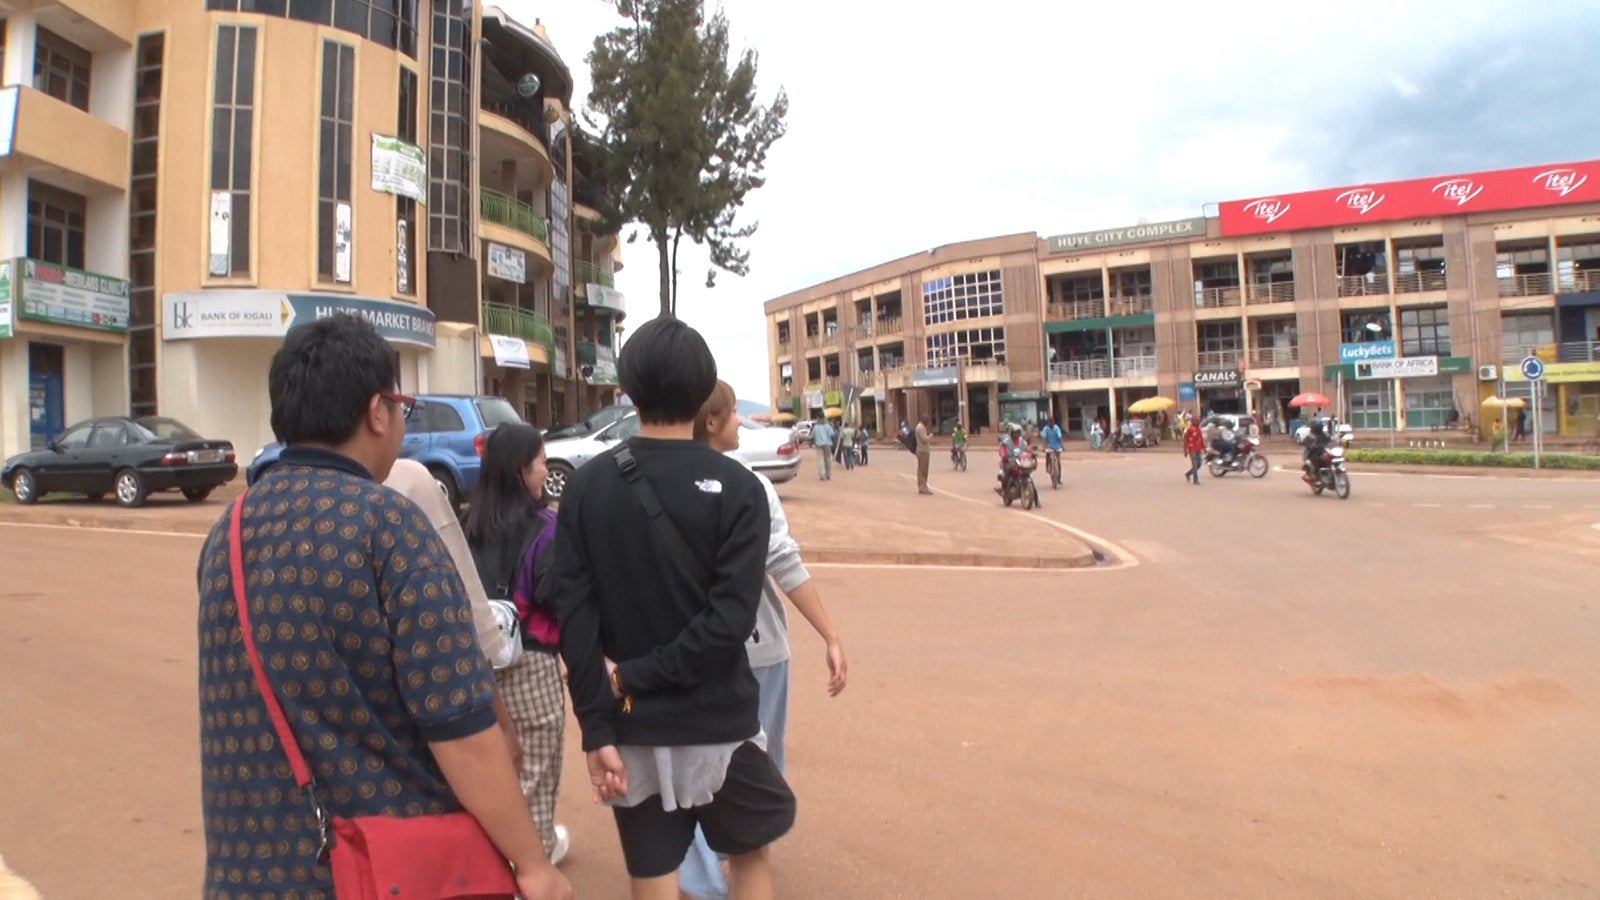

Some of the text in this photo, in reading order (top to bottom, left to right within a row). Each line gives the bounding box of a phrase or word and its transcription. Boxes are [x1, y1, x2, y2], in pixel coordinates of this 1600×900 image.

[1057, 221, 1193, 248] HUYE CITY COMPLEX
[200, 311, 273, 321] BANK OF KIGALI
[361, 308, 411, 331] MARKET
[1341, 344, 1393, 359] LuckyBets
[1371, 359, 1435, 369] BANK OF AFRICA
[1194, 370, 1237, 382] CANAL+
